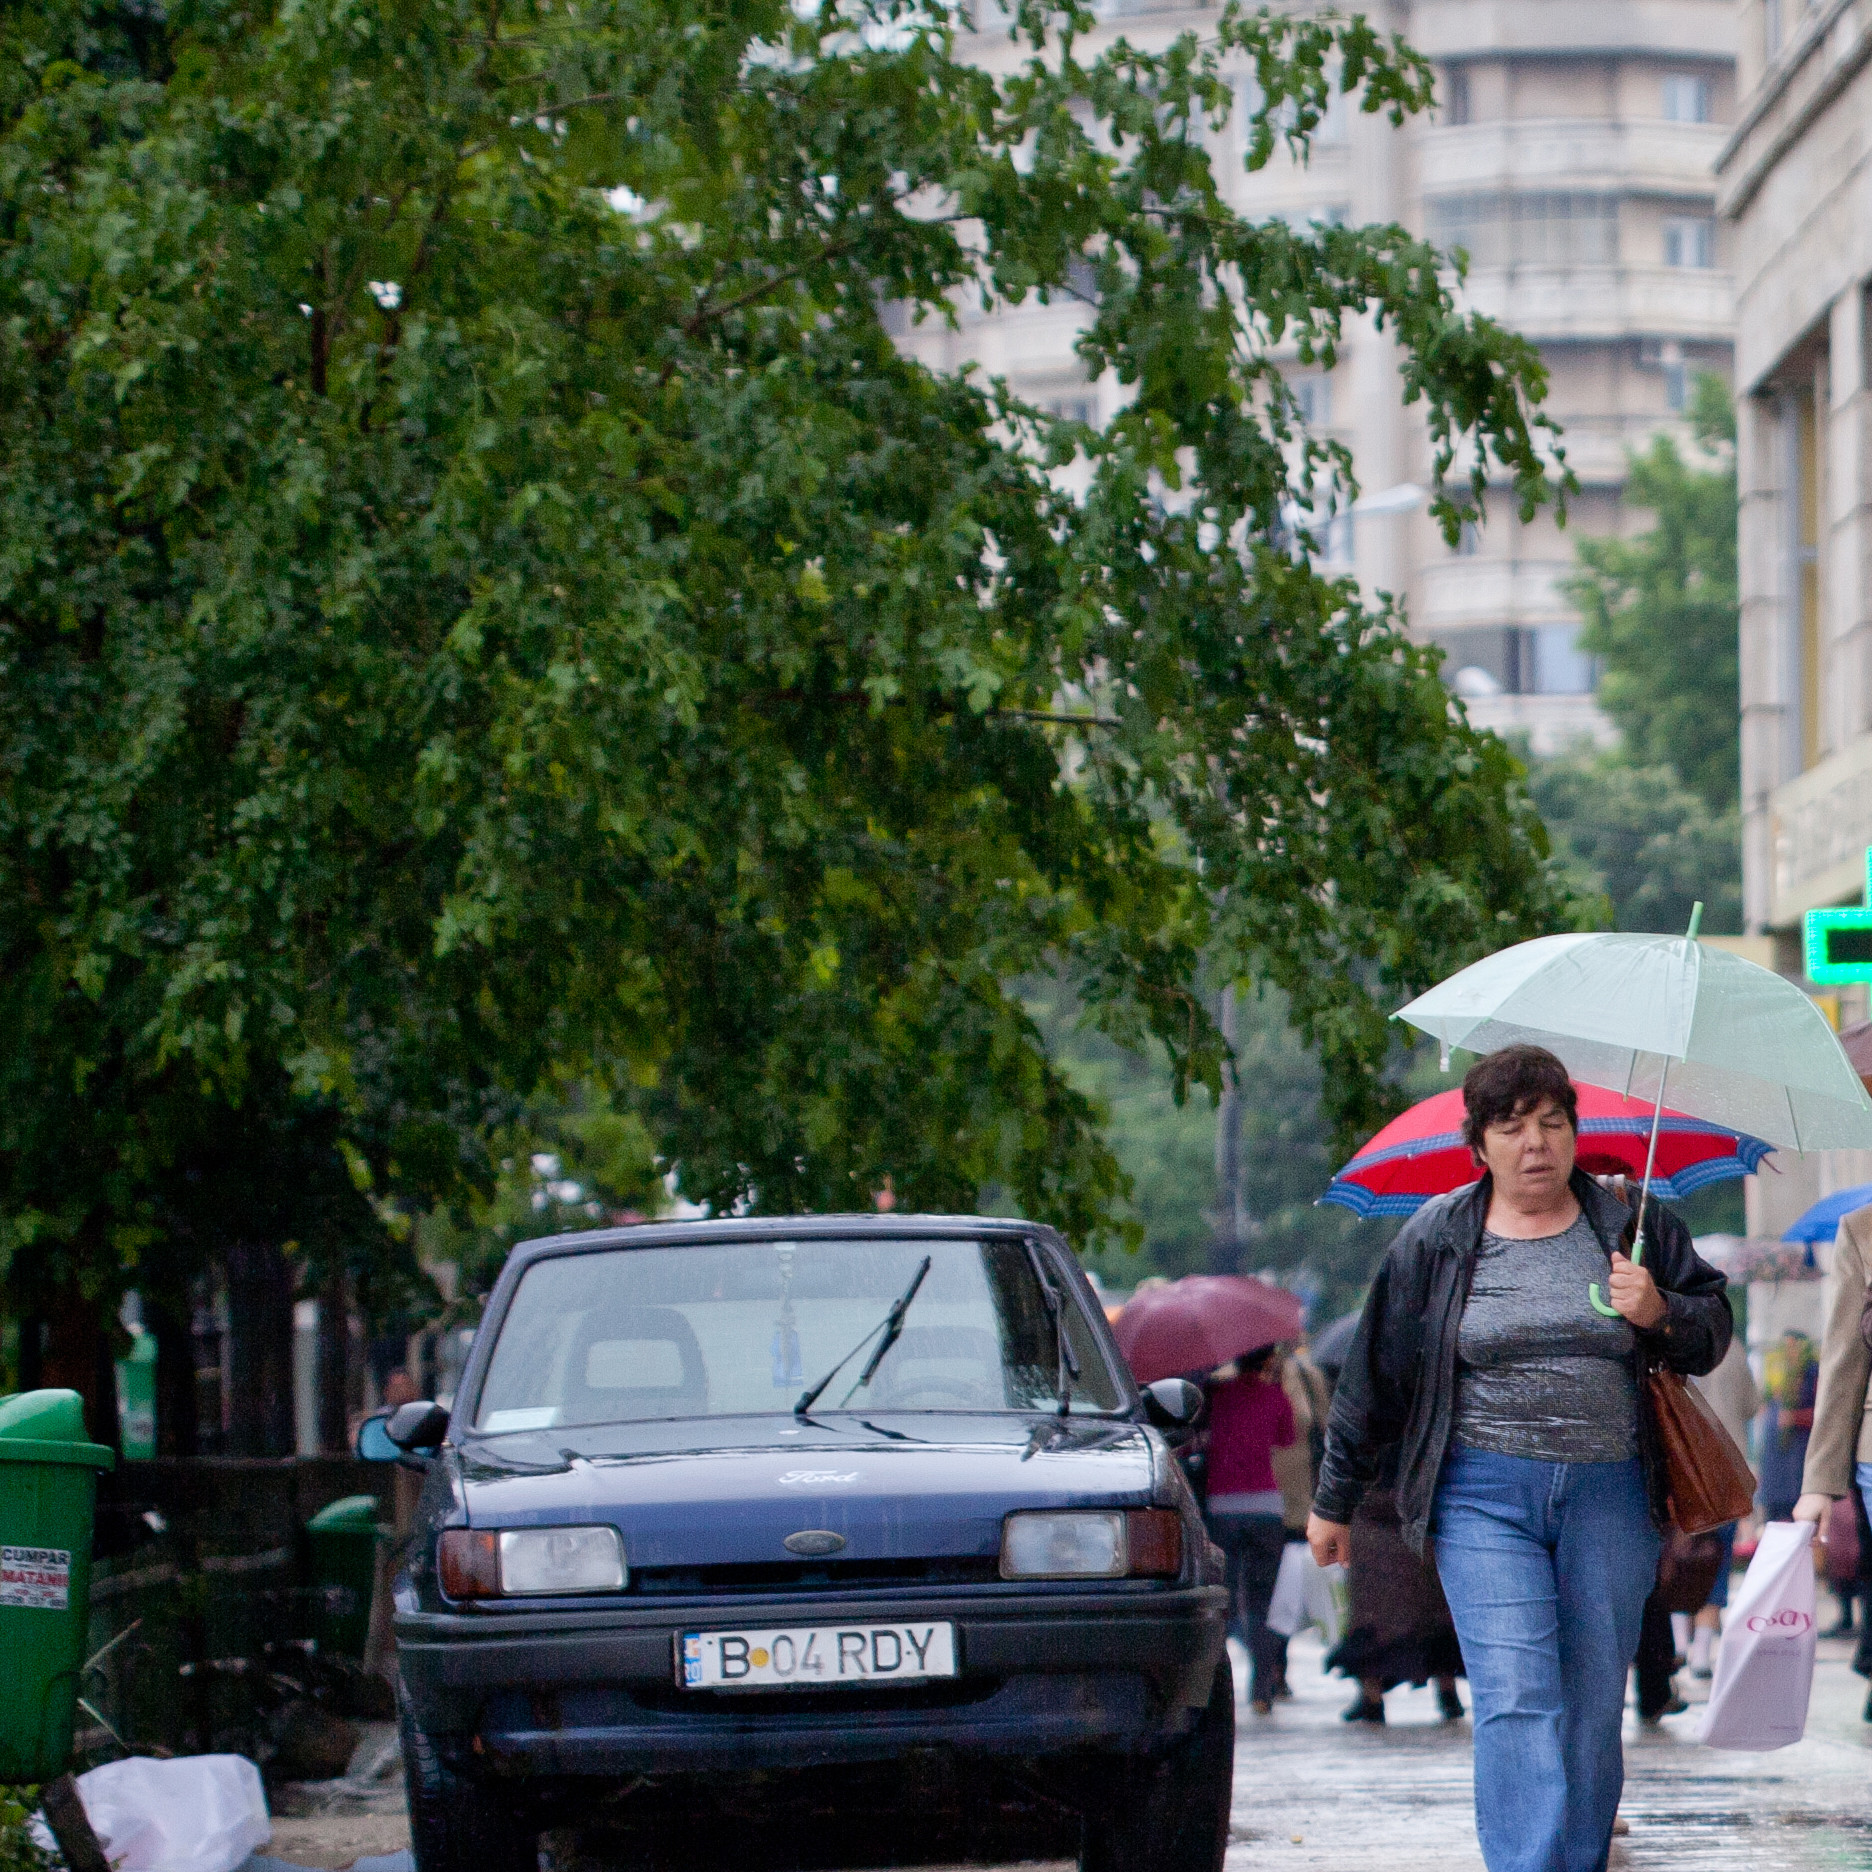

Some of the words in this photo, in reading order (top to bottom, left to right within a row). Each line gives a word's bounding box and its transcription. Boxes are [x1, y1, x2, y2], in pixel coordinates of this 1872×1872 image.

[778, 1469, 860, 1485] Ford
[3, 1548, 69, 1564] CUMPAR
[718, 1636, 751, 1679] B
[771, 1633, 824, 1677] 04
[837, 1627, 934, 1674] RDY
